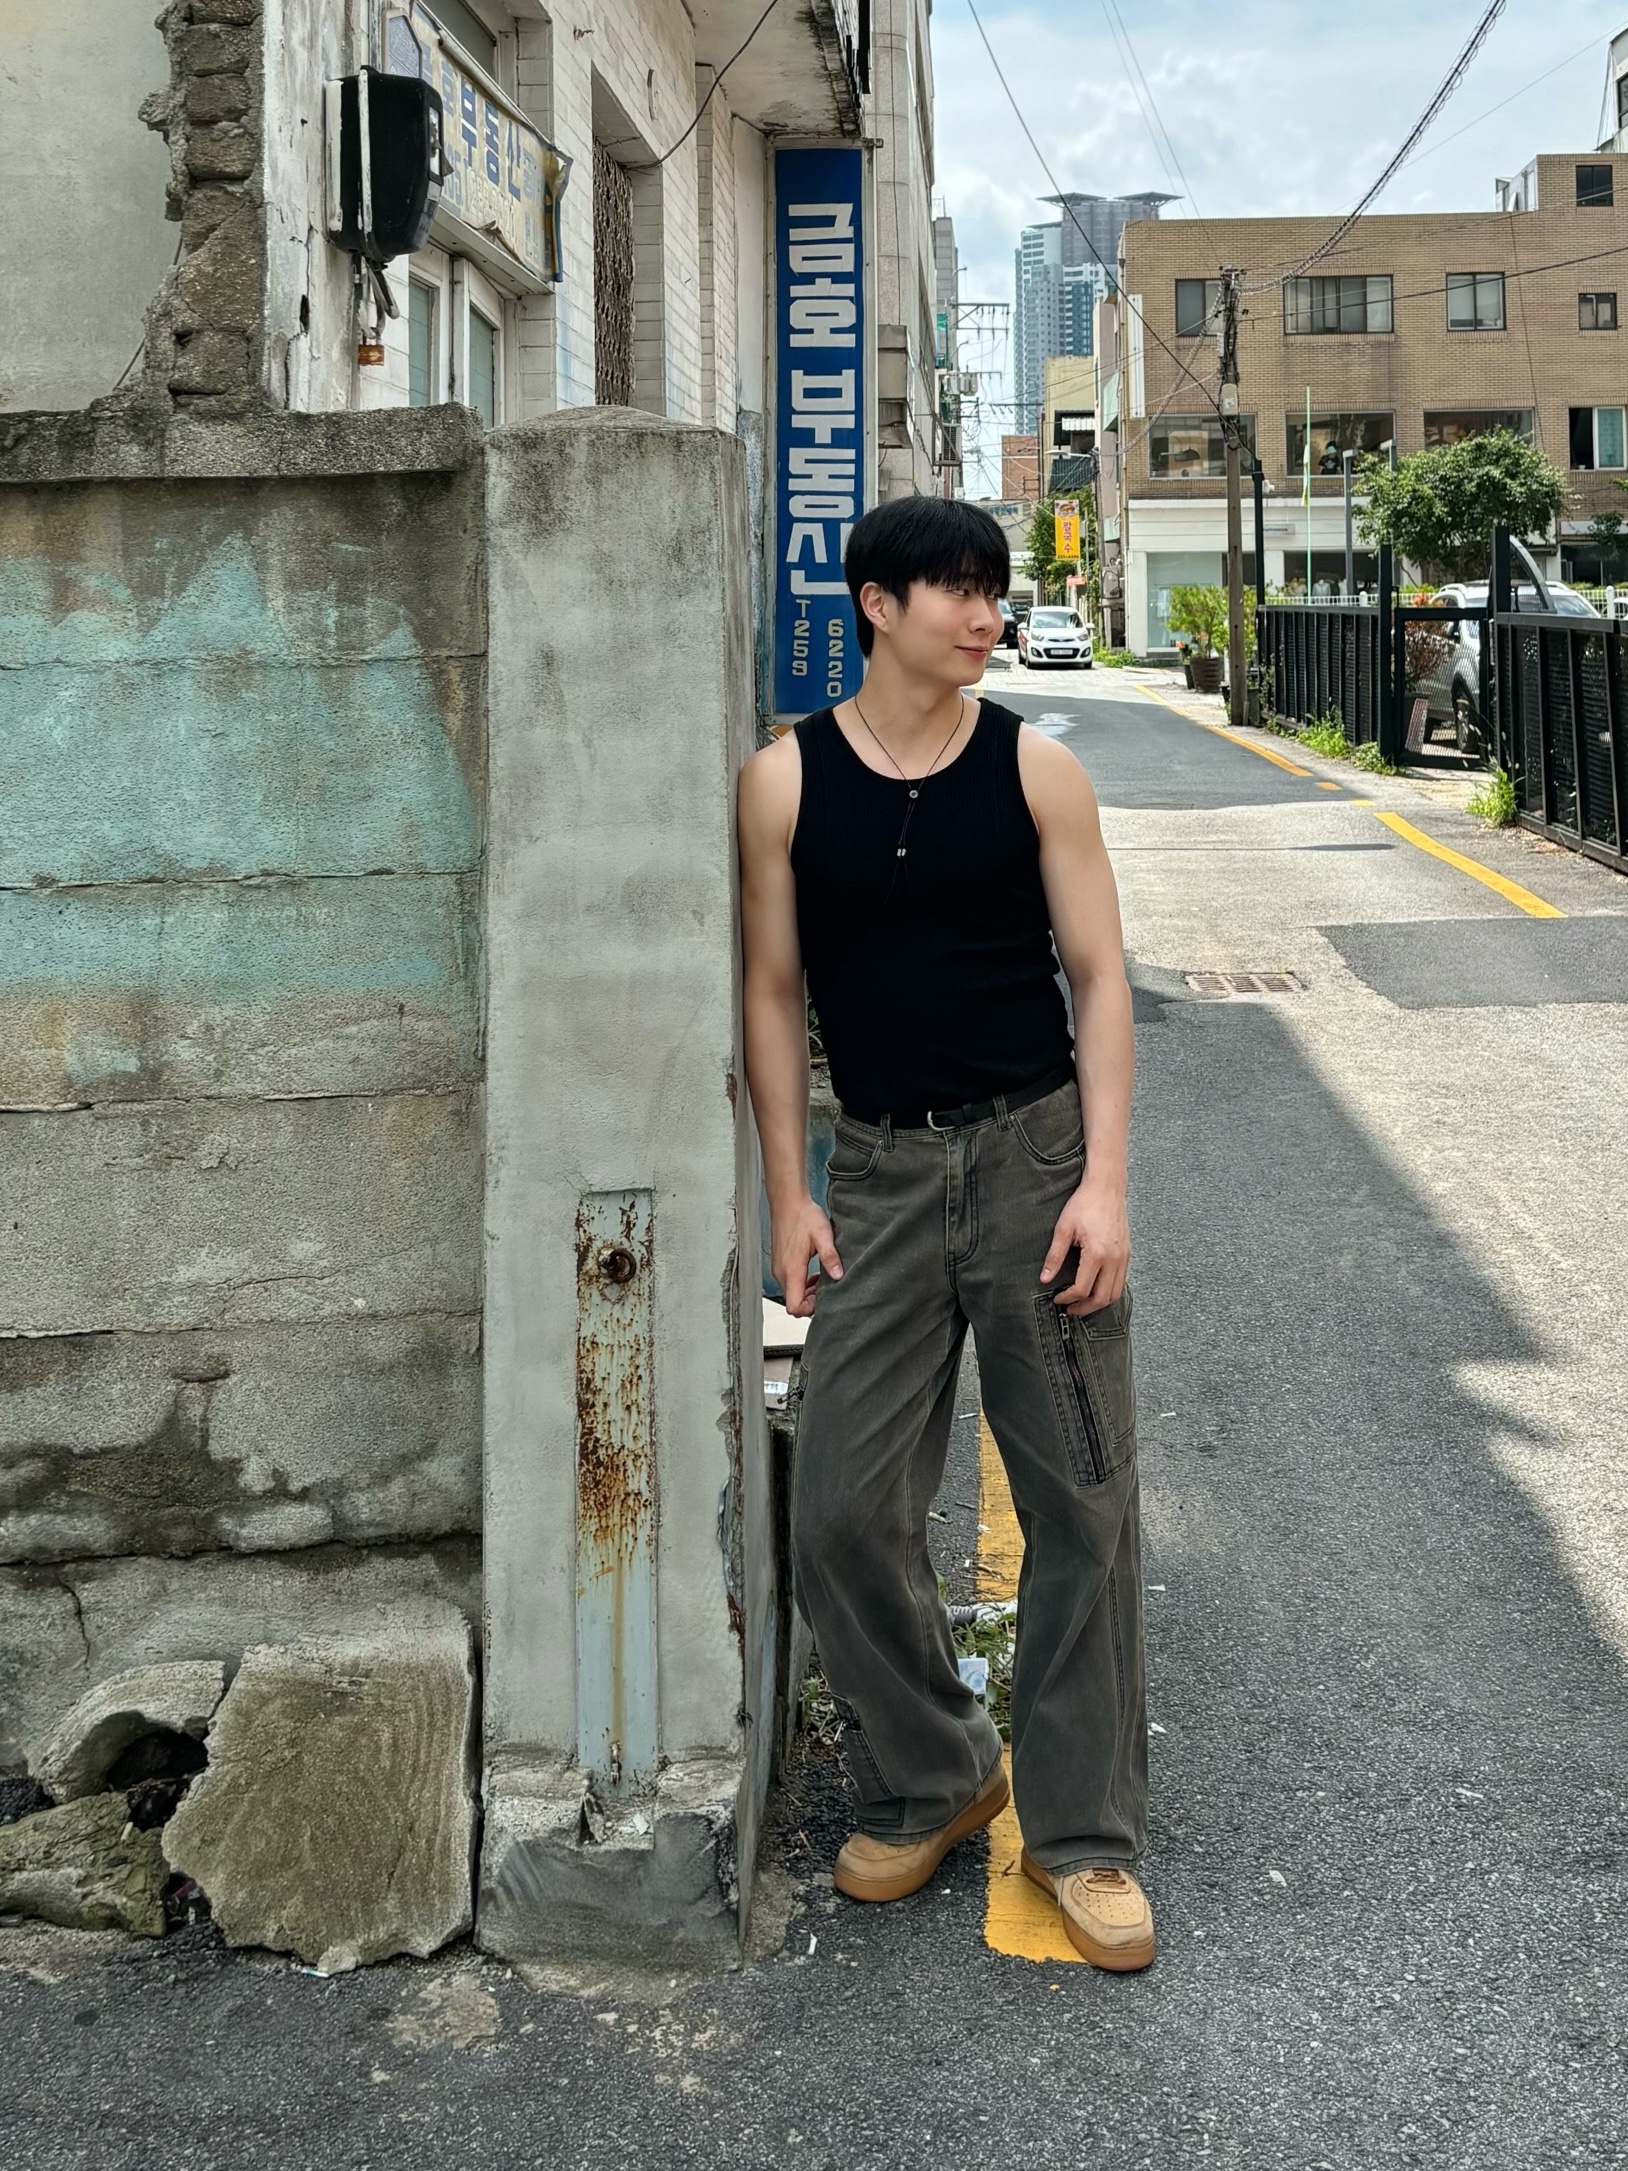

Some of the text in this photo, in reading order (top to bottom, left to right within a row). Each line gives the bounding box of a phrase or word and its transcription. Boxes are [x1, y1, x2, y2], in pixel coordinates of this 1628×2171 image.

[460, 75, 522, 203] 부동산
[785, 203, 856, 595] 금호 부동산
[826, 618, 844, 698] 6220
